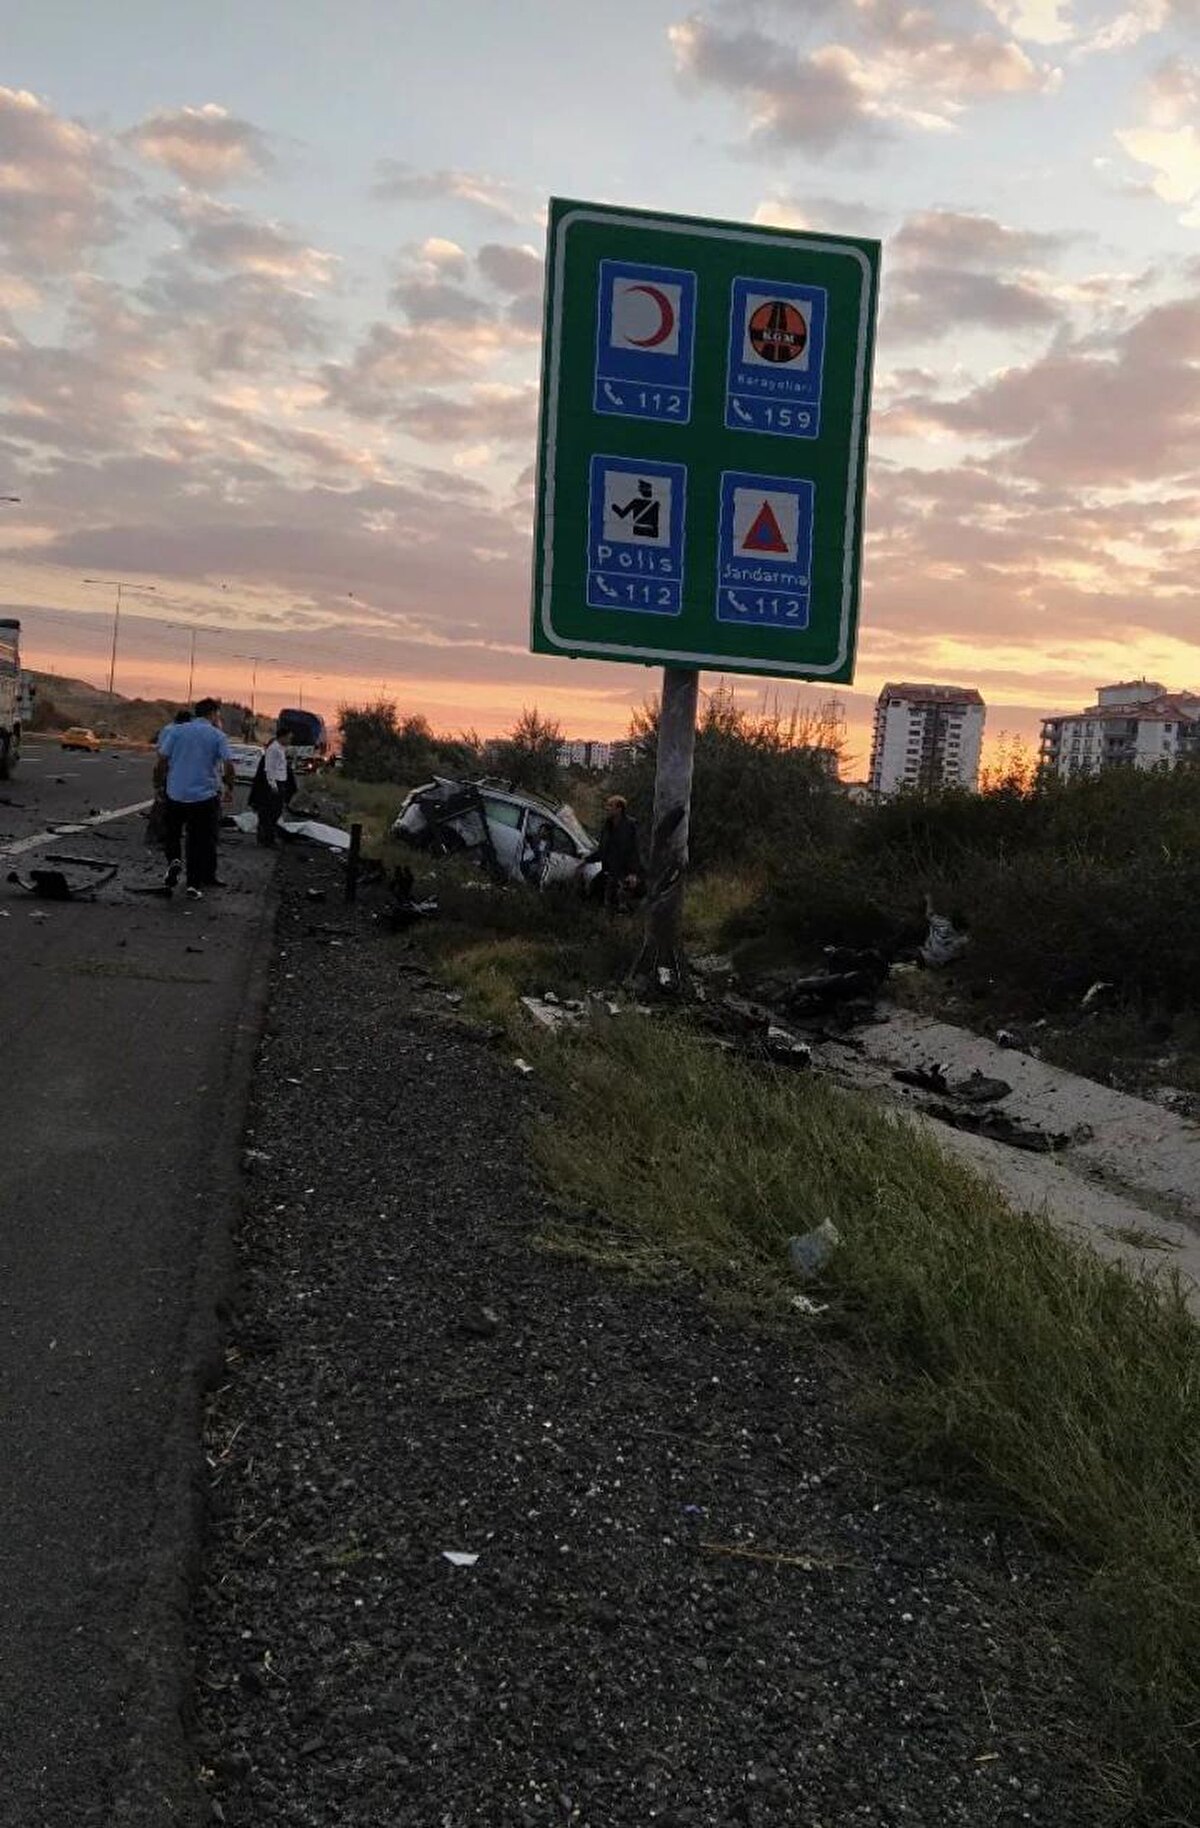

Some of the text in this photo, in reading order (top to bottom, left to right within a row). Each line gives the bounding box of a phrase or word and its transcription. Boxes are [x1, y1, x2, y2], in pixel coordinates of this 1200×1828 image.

[639, 391, 681, 414] 112
[764, 408, 811, 429] 159
[598, 545, 673, 573] Polis
[723, 563, 809, 587] Jandarma
[626, 584, 672, 605] 112
[756, 597, 800, 618] 112
